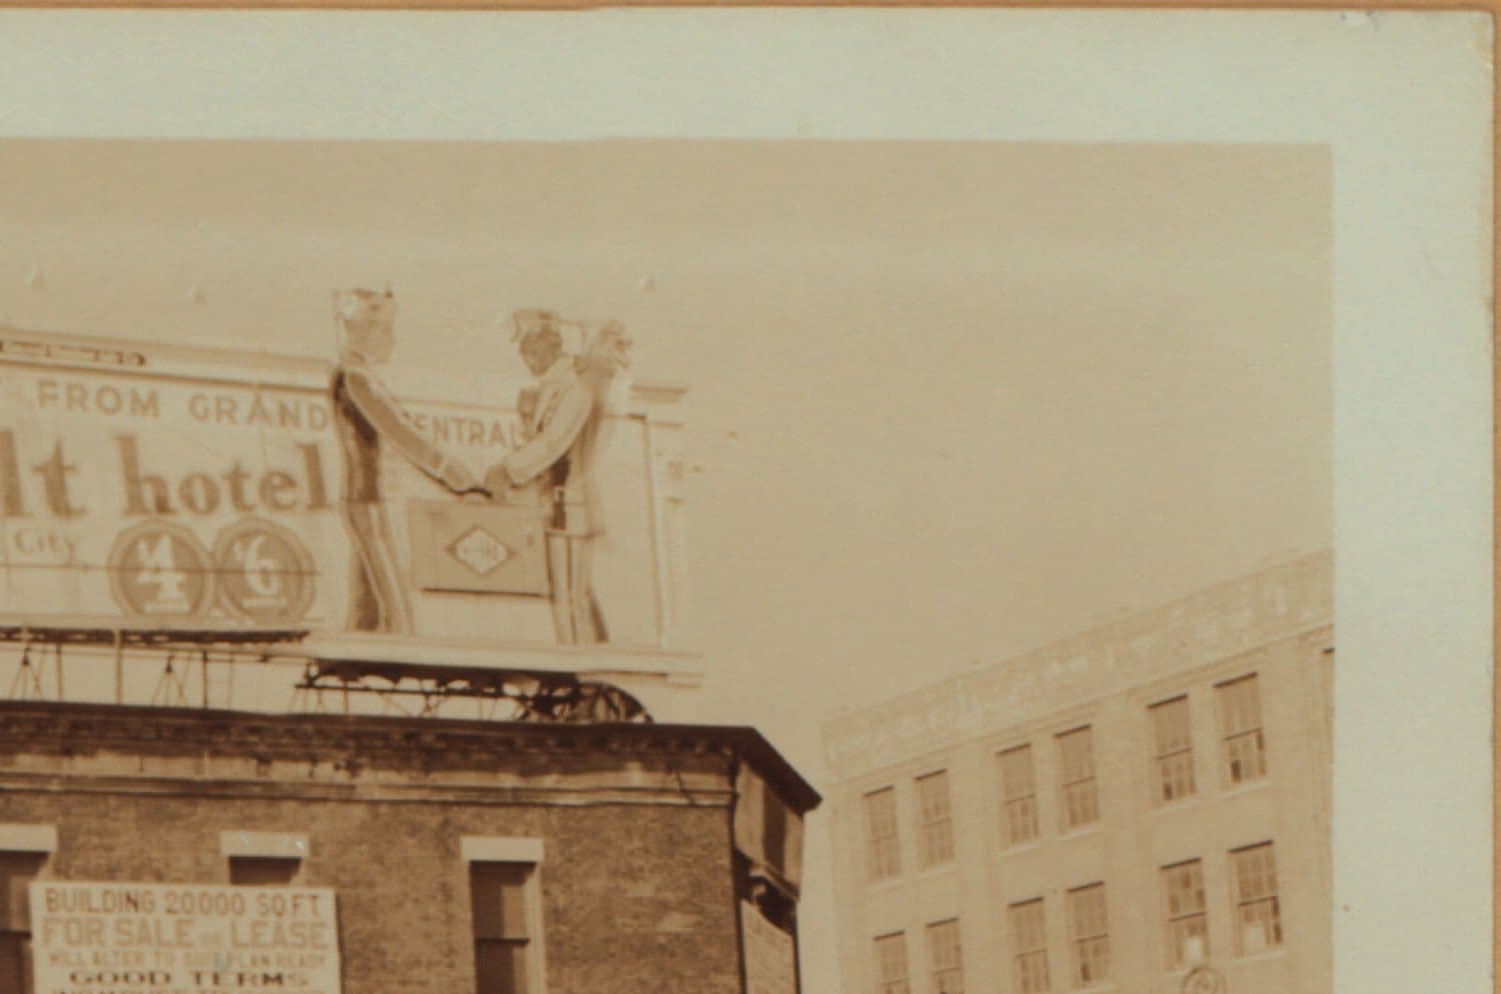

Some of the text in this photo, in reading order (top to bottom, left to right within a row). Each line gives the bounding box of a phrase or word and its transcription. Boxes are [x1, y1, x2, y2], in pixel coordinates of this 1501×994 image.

[37, 379, 160, 417] FROM
[188, 394, 330, 431] GRAND
[401, 408, 523, 451] ENTRAL
[112, 435, 335, 516] hotel
[14, 529, 81, 559] City
[45, 888, 155, 914] BUILDING
[164, 890, 245, 917] 20000
[43, 916, 105, 946] FOR
[115, 917, 195, 948] SALE
[230, 919, 329, 950] LEASE
[69, 969, 173, 987] GOOD
